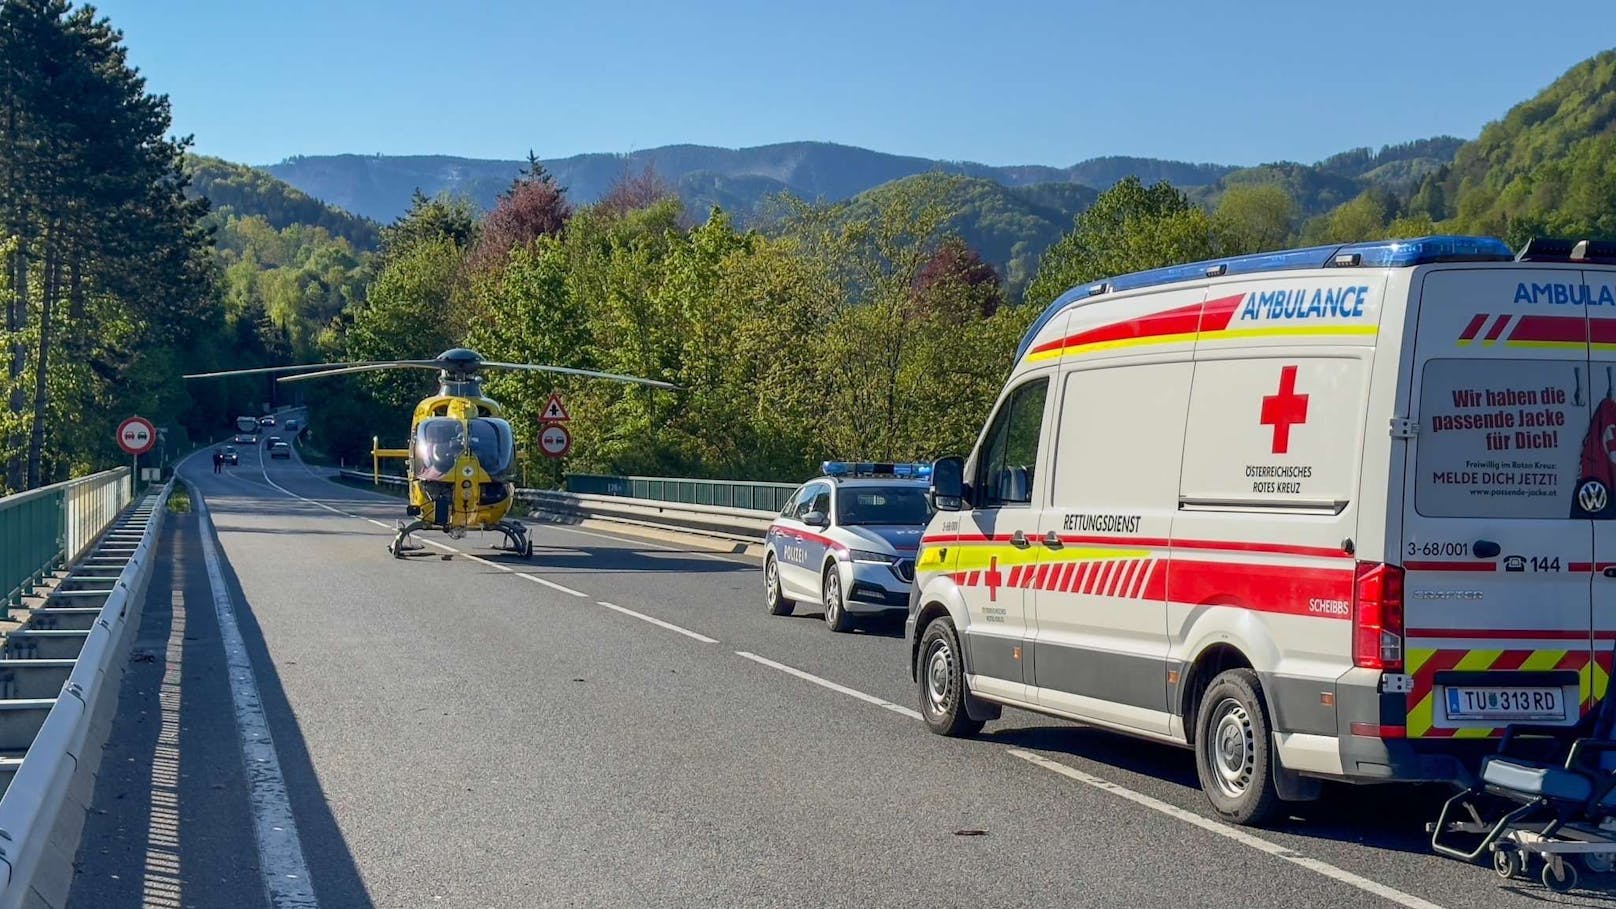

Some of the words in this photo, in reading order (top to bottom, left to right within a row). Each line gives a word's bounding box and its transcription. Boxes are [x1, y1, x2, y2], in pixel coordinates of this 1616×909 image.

[1241, 286, 1369, 320] AMBULANCE
[1513, 282, 1616, 306] AMBULA
[1452, 389, 1482, 408] Wir
[1486, 388, 1537, 407] haben
[1541, 387, 1566, 405] die
[1432, 410, 1514, 432] passende
[1518, 409, 1565, 428] Jacke
[1486, 432, 1511, 451] für
[1515, 431, 1558, 449] Dich!
[1245, 463, 1312, 478] ÖSTERREICHISCHES
[1465, 460, 1500, 470] Freiwillig
[1501, 461, 1511, 469] im
[1253, 482, 1275, 493] ROTES
[1277, 482, 1301, 494] KREUZ
[1433, 472, 1478, 485] MELDE
[1482, 472, 1514, 485] DICH
[1518, 473, 1557, 486] JETZT!
[1063, 514, 1141, 533] RETTUNGSDIENST
[783, 544, 805, 563] POLIZEI
[1408, 542, 1468, 557] 3-68/001
[1530, 557, 1561, 572] 144
[1412, 590, 1484, 600] CRAFTER
[1309, 598, 1349, 615] SCHEIBBS
[1464, 691, 1487, 710] TU
[1501, 691, 1530, 710] 313
[1533, 692, 1555, 711] RD
